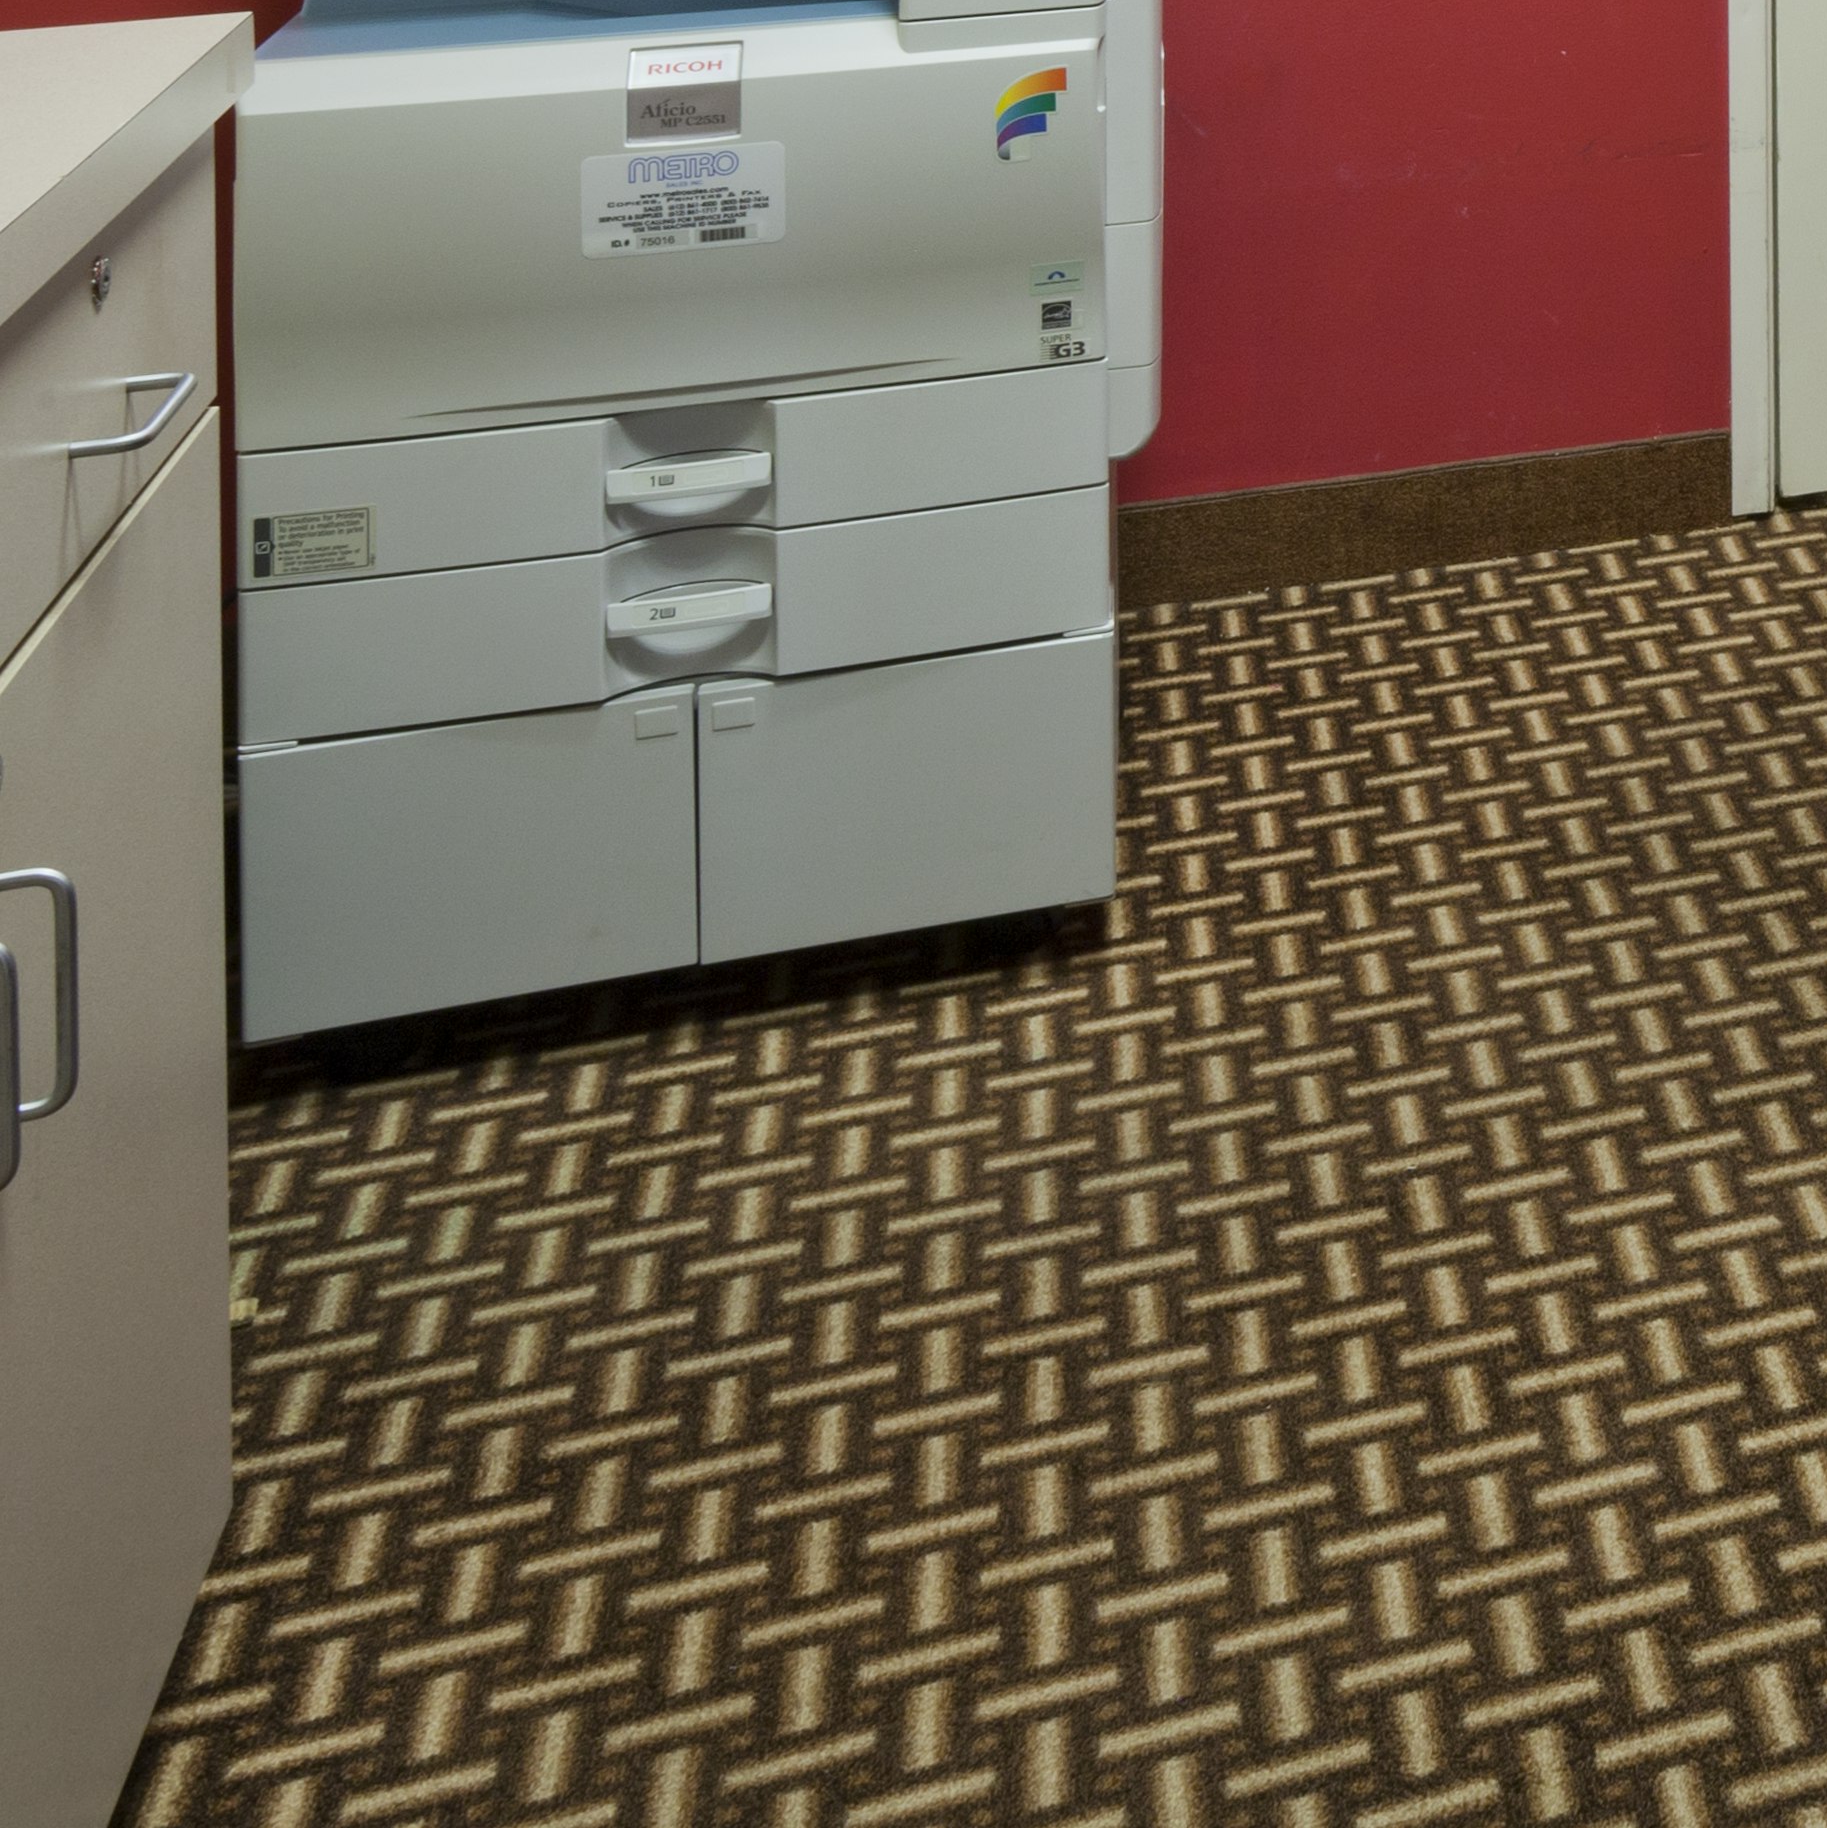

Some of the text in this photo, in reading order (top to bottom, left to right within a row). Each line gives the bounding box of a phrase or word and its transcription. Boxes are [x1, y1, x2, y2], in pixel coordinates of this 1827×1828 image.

[647, 59, 724, 75] RICOH
[640, 98, 697, 121] Aficio
[660, 114, 727, 129] MP C2551
[628, 150, 739, 184] METRO
[640, 234, 676, 247] 75016
[1040, 332, 1072, 345] SUPER
[1053, 340, 1086, 360] G3
[649, 474, 656, 488] 1
[648, 607, 659, 621] 2
